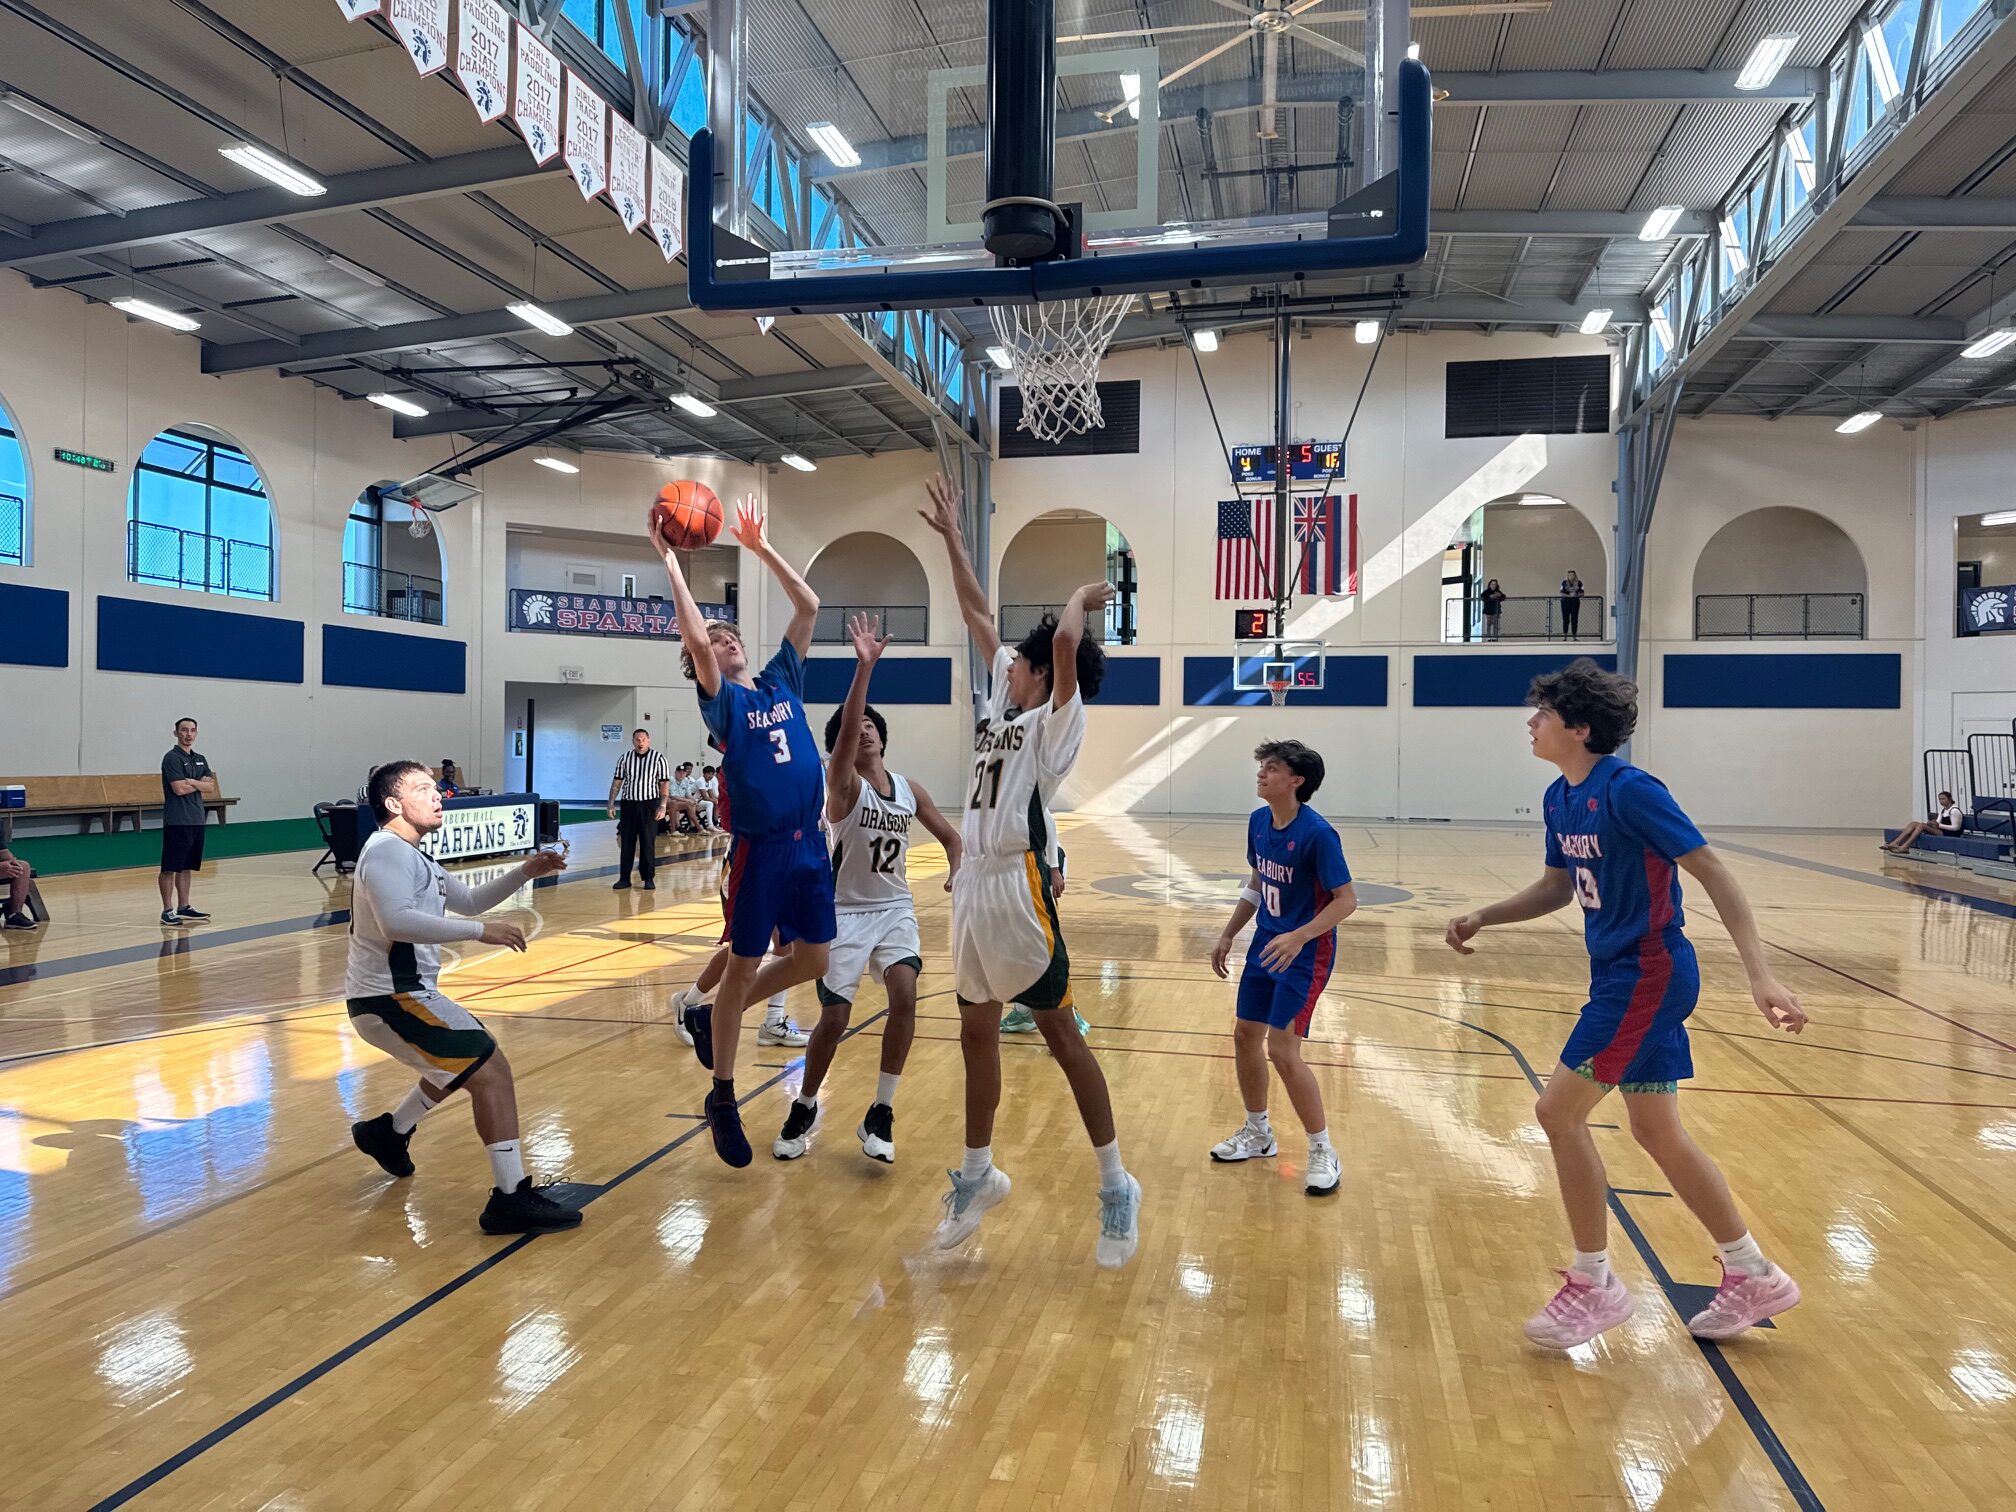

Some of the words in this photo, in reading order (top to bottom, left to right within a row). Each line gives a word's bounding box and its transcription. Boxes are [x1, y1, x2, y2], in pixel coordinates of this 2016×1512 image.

[393, 0, 447, 56] CHAMPIONS
[464, 0, 506, 43] PADDLING
[471, 25, 499, 60] 2017
[528, 42, 551, 70] GIRLS
[471, 45, 498, 75] STATE
[520, 48, 558, 88] PADDLING
[526, 73, 551, 105] 2017
[575, 85, 597, 110] GIRLS
[528, 92, 552, 120] STATE
[575, 97, 599, 125] TRACK
[576, 115, 599, 145] 2017
[577, 133, 598, 159] STATE
[658, 185, 677, 212] 2018
[1235, 448, 1262, 456] HOME
[1240, 457, 1251, 472] 4
[1301, 445, 1312, 463] 5
[557, 596, 662, 615] SEABURY
[556, 609, 683, 635] SPARTA
[1252, 613, 1264, 633] 2
[1298, 672, 1315, 686] 55
[769, 728, 791, 764] 3
[970, 758, 1004, 810] 21
[444, 813, 470, 826] ABURY
[474, 810, 493, 822] HALL
[869, 836, 901, 874] 12
[1256, 853, 1294, 884] EABURY
